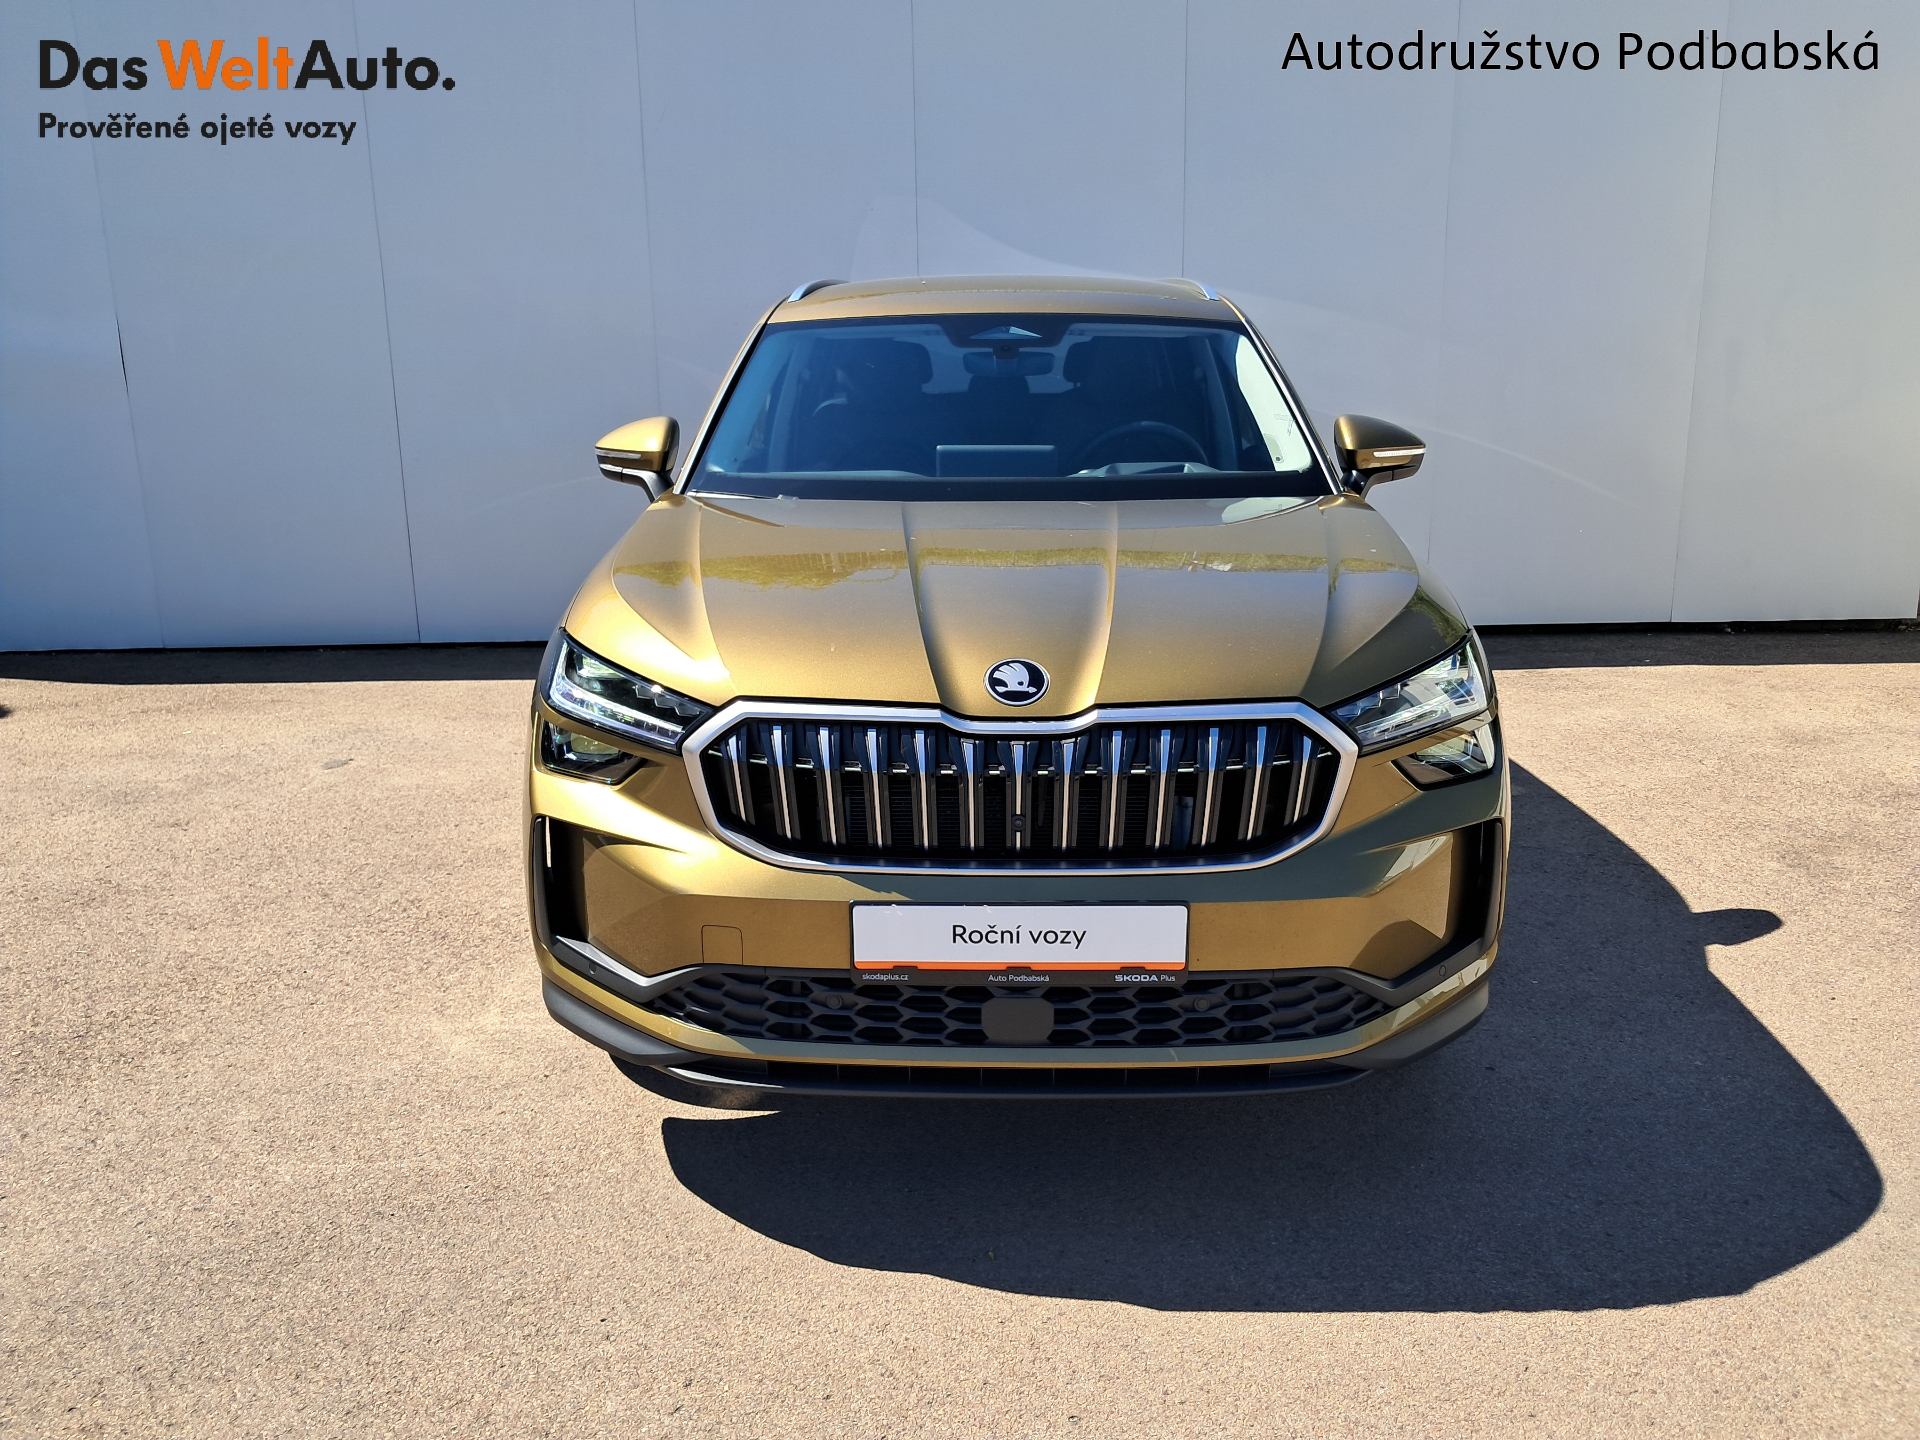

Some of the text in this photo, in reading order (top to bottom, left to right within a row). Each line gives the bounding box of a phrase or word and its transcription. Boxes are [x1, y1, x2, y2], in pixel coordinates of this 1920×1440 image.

[952, 924, 1087, 950] Roční vozy
[861, 972, 909, 982] skodaplus.cz
[987, 974, 1050, 982] Auto Podbabská
[1160, 974, 1176, 982] Plus
